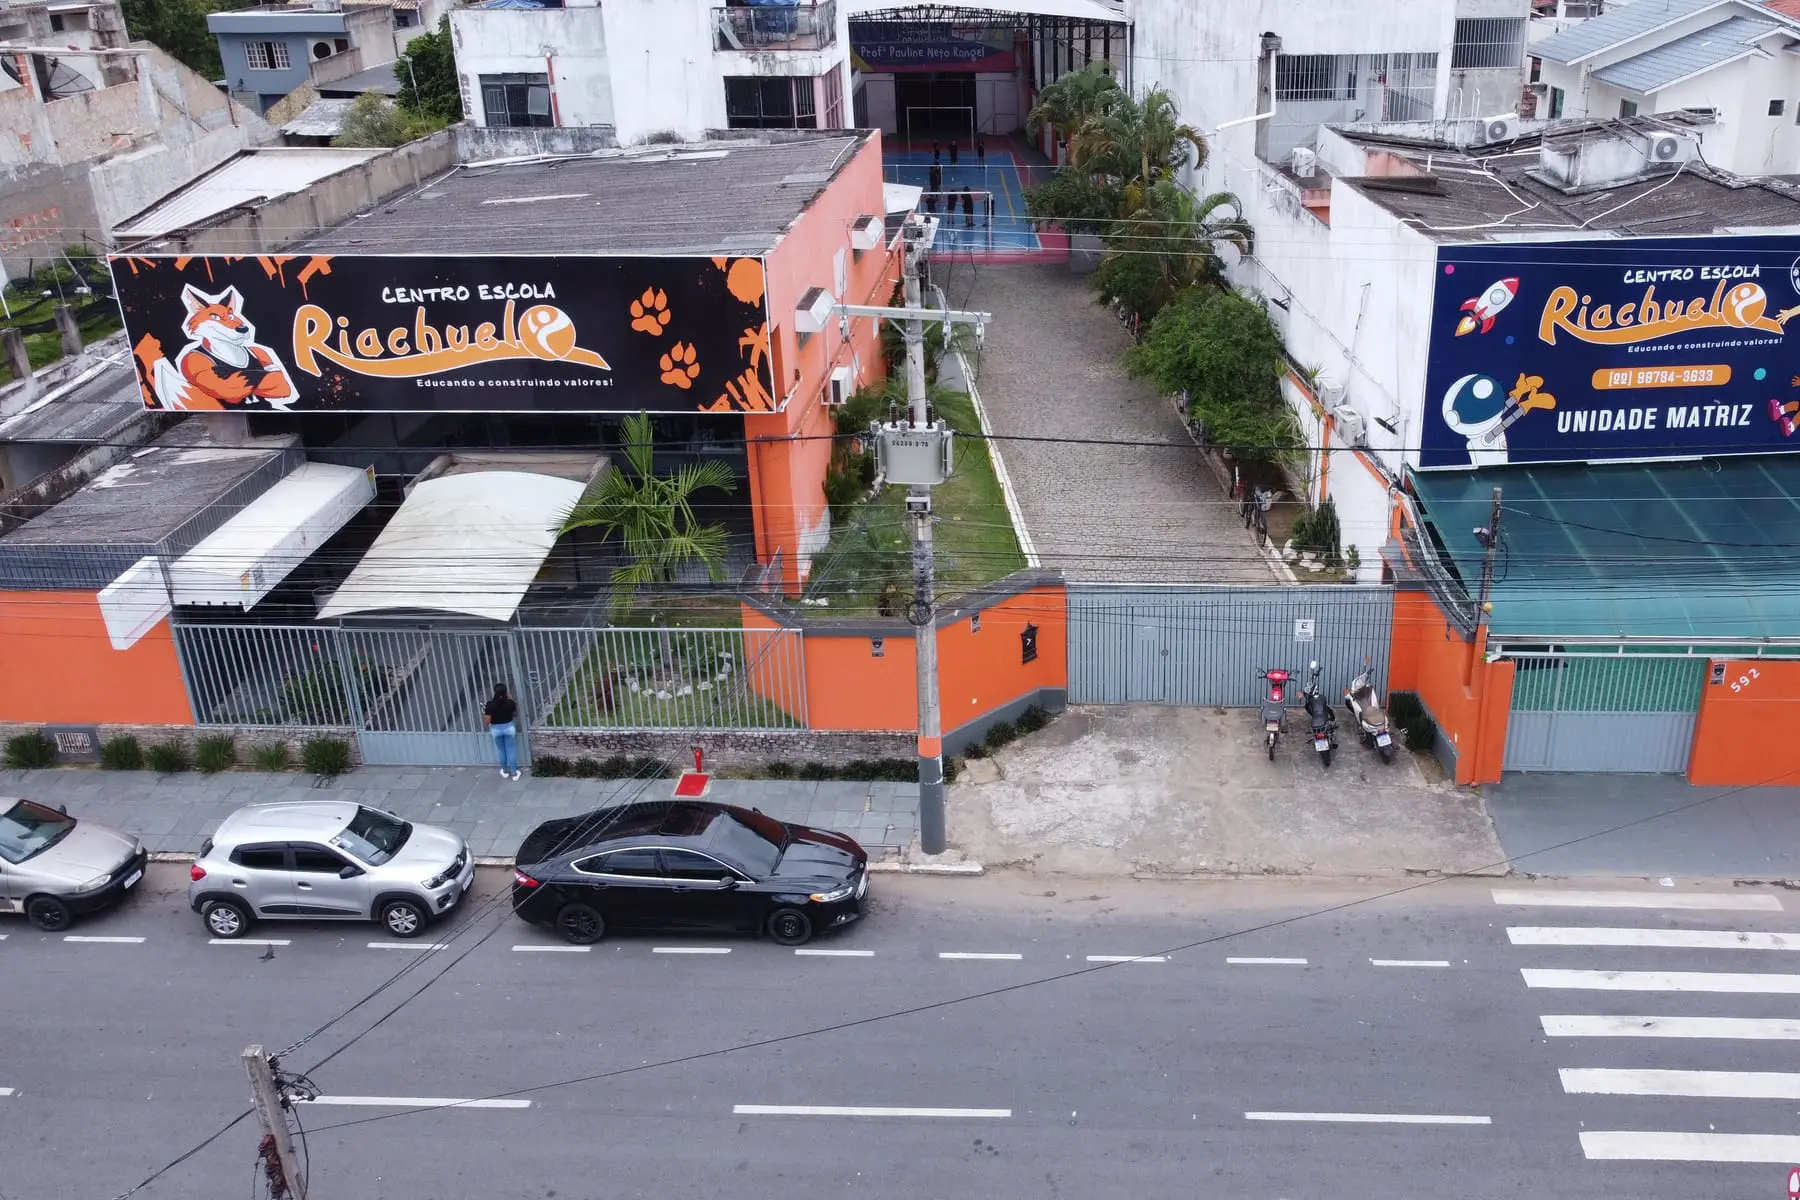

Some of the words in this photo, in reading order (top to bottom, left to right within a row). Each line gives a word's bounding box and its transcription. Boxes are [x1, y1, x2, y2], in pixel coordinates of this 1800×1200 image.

[889, 45, 924, 58] Pauline
[926, 47, 950, 60] Neto
[953, 46, 985, 62] Rangel
[1623, 268, 1694, 284] CENTRO
[1700, 263, 1760, 280] ESCOLA
[381, 285, 470, 304] CENTRO
[478, 281, 556, 300] ESCOLA
[1627, 344, 1675, 353] Educando
[1684, 340, 1742, 350] construindo
[1744, 337, 1784, 347] valores!
[416, 378, 476, 388] Educando
[478, 379, 486, 387] e
[487, 378, 561, 388] construindo
[563, 378, 614, 388] valores!
[1557, 407, 1657, 433] UNIDADE
[1665, 403, 1754, 429] MATRIZ
[1730, 668, 1761, 693] 592
